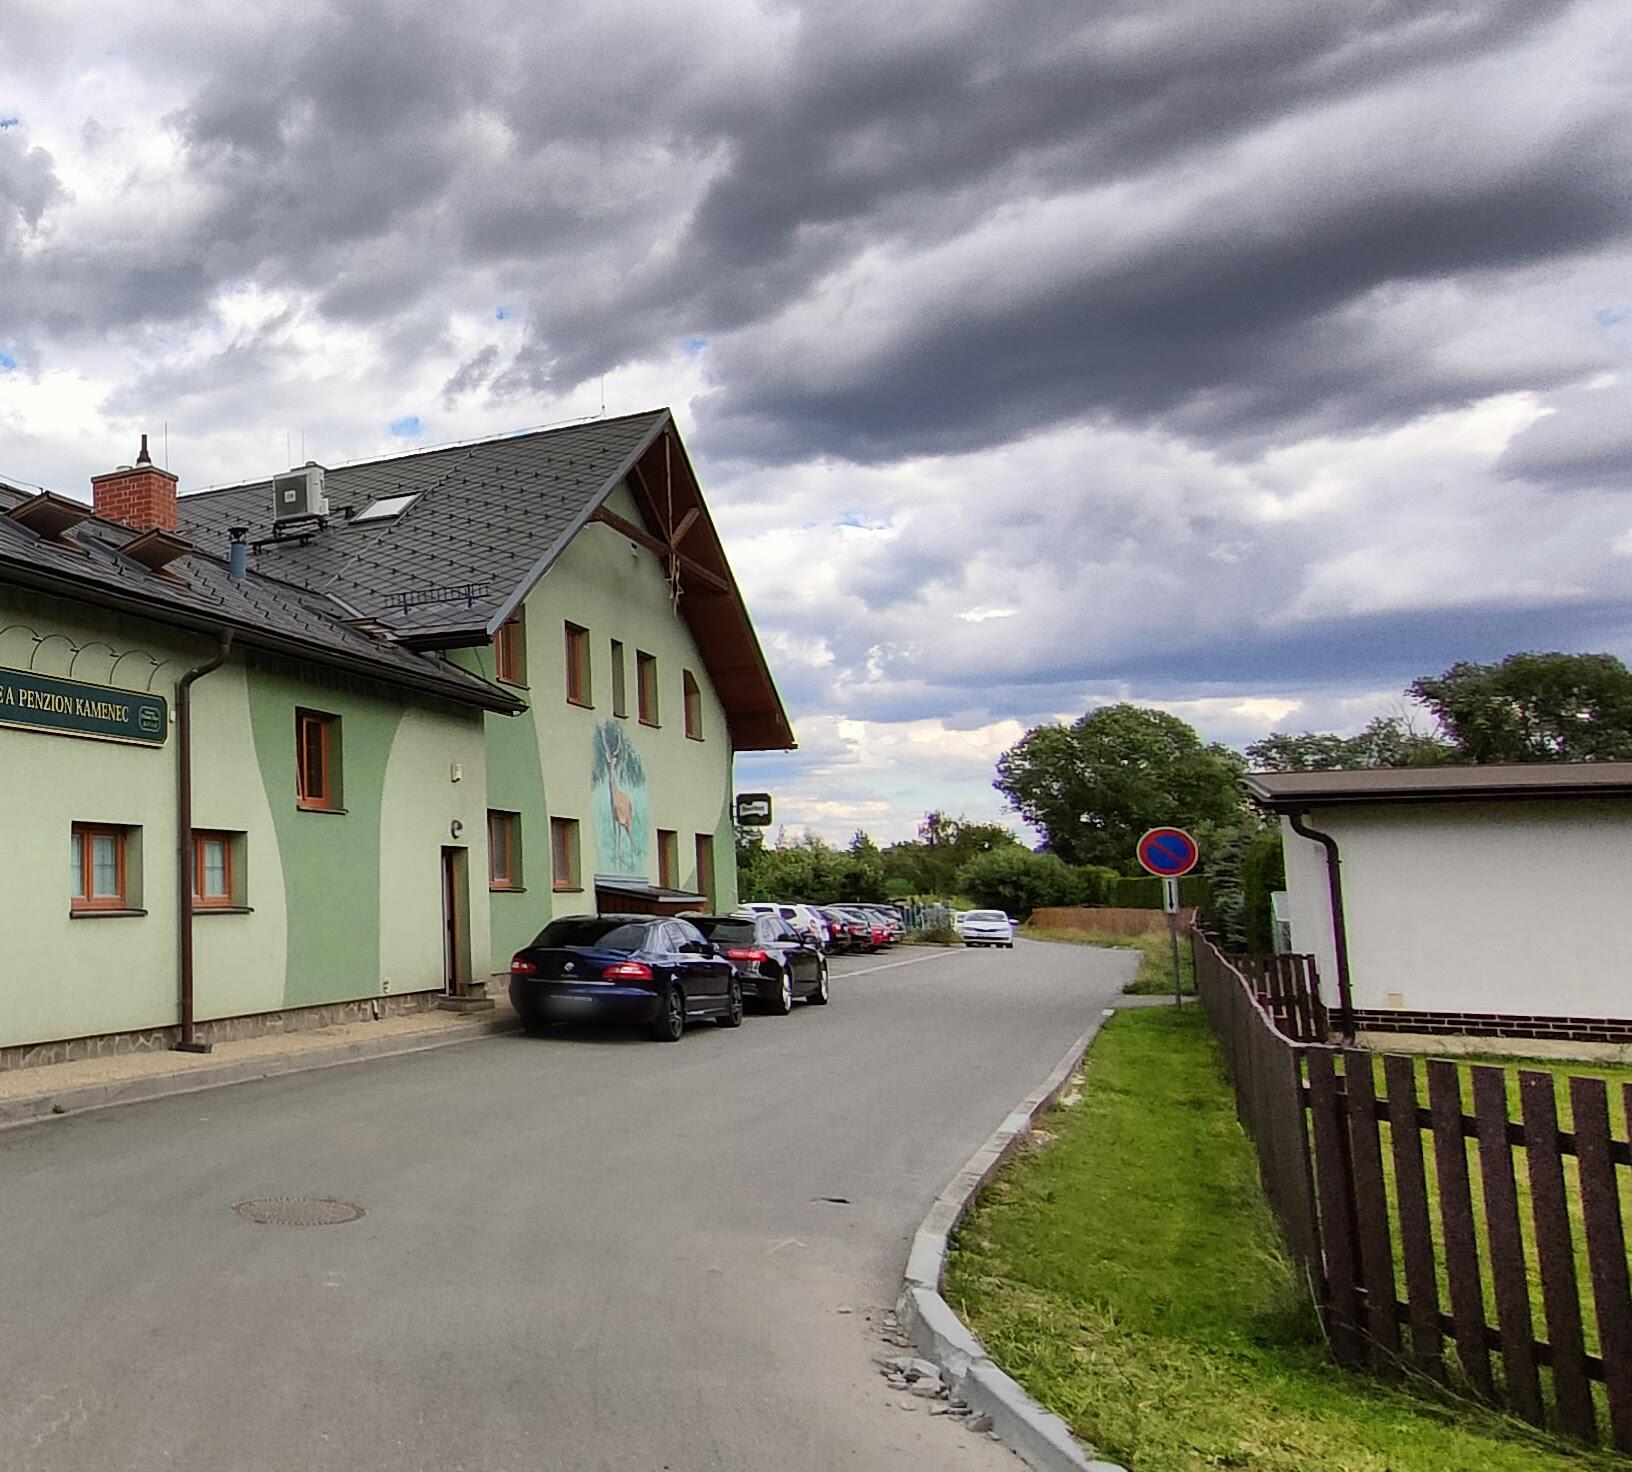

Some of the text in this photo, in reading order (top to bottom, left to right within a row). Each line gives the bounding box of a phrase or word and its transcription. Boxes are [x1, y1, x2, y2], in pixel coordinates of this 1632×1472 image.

[5, 686, 15, 706] A
[18, 688, 73, 715] PENZION
[75, 698, 129, 723] KAMENEC
